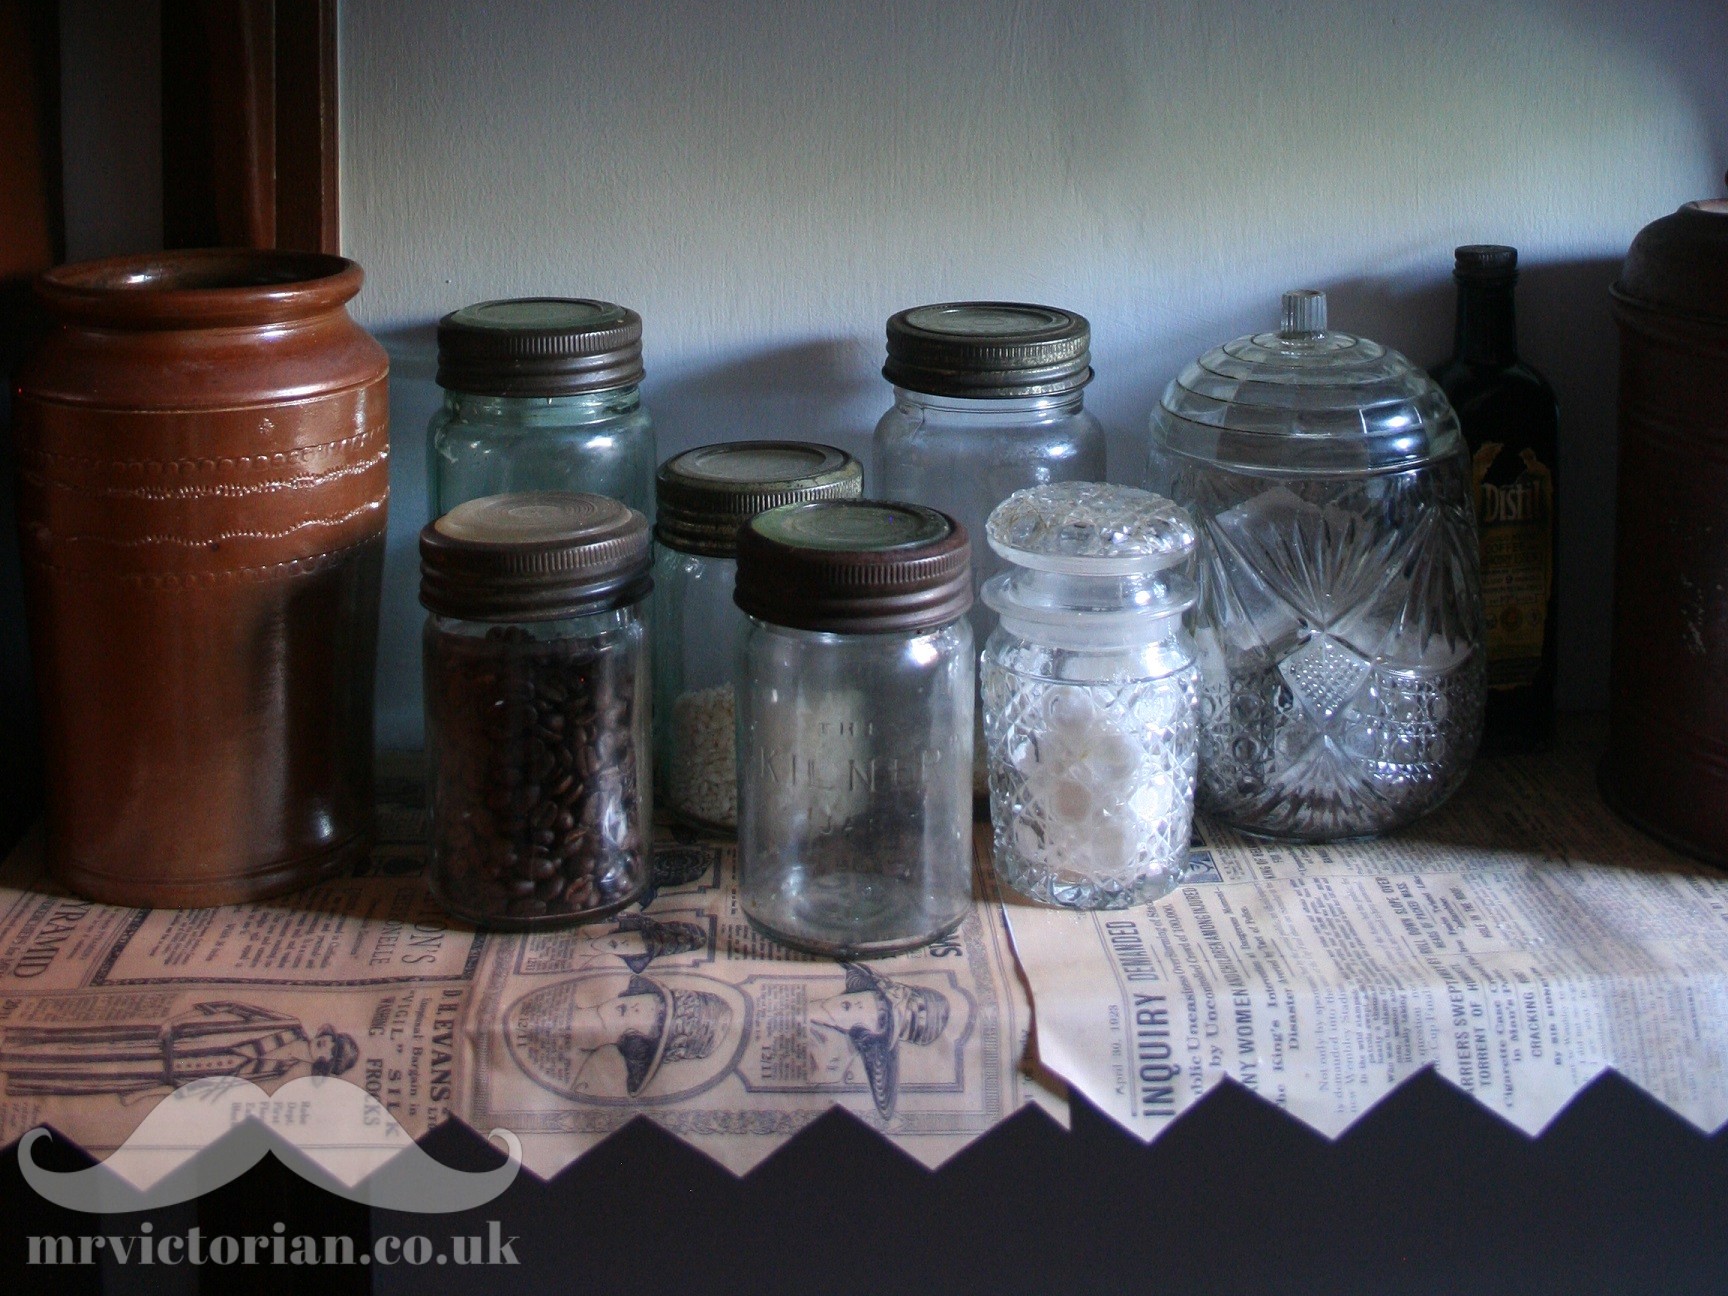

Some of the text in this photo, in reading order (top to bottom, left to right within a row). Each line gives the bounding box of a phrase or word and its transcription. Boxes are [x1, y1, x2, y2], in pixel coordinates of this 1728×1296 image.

[759, 747, 943, 794] KILNER
[1182, 887, 1211, 915] INJURED
[1375, 876, 1394, 894] OVER
[1386, 896, 1408, 915] SLOPE
[1175, 934, 1188, 942] of
[1195, 914, 1221, 942] AMONG
[1401, 917, 1421, 936] DOWN
[1428, 930, 1447, 949] HEADS
[1208, 941, 1239, 974] CHILDREN
[1105, 920, 1182, 1119] INQUIRY DEMANDED
[1178, 974, 1202, 1051] Uneasiness
[1284, 988, 1300, 1051] Disaster
[1445, 979, 1469, 1027] SWEPT
[1492, 1000, 1506, 1034] Case
[1231, 988, 1256, 1054] WOMEN
[1428, 1025, 1439, 1050] Cup
[1505, 998, 1520, 1043] Man's
[1522, 991, 1544, 1059] CRACKING
[430, 1019, 455, 1102] EVANS
[1208, 1044, 1224, 1067] by
[1269, 1019, 1286, 1073] King's
[1468, 1001, 1492, 1088] TORRENT OF
[408, 1046, 424, 1096] Bargain
[760, 1045, 773, 1079] 12/11
[363, 1058, 385, 1127] FROCKS
[1111, 1063, 1125, 1096] April
[1318, 1068, 1329, 1092] Not
[409, 1104, 420, 1116] in
